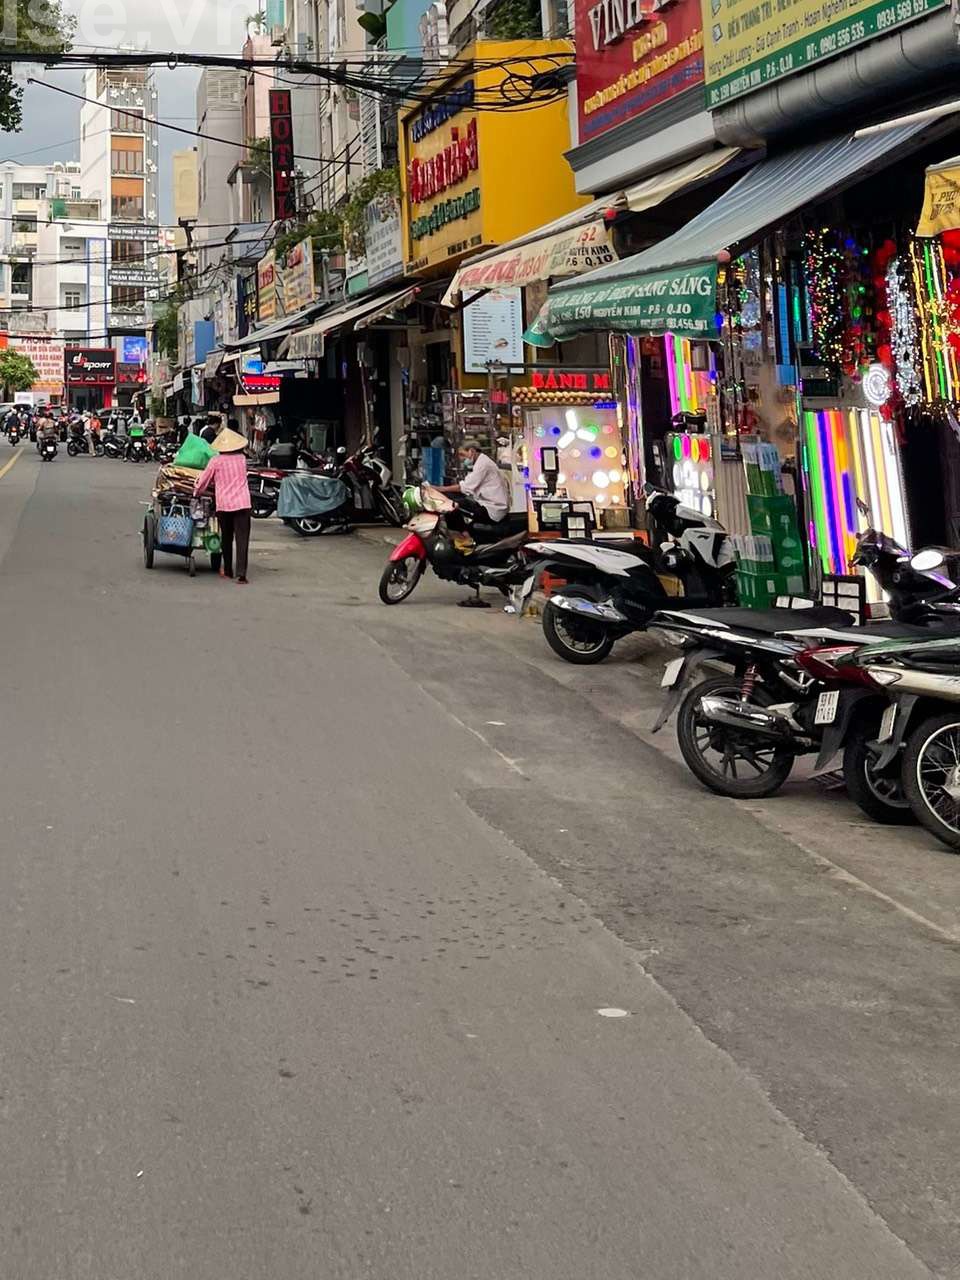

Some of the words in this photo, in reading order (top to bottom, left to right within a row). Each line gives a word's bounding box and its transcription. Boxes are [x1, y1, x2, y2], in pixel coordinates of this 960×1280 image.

[876, 6, 893, 31] 0934
[271, 91, 296, 220] HOTEL
[591, 244, 610, 256] KIM
[669, 273, 712, 296] SÁNG
[624, 305, 640, 316] KIM
[667, 303, 692, 315] Q.10
[532, 368, 587, 389] BÁNH
[593, 373, 609, 389] M
